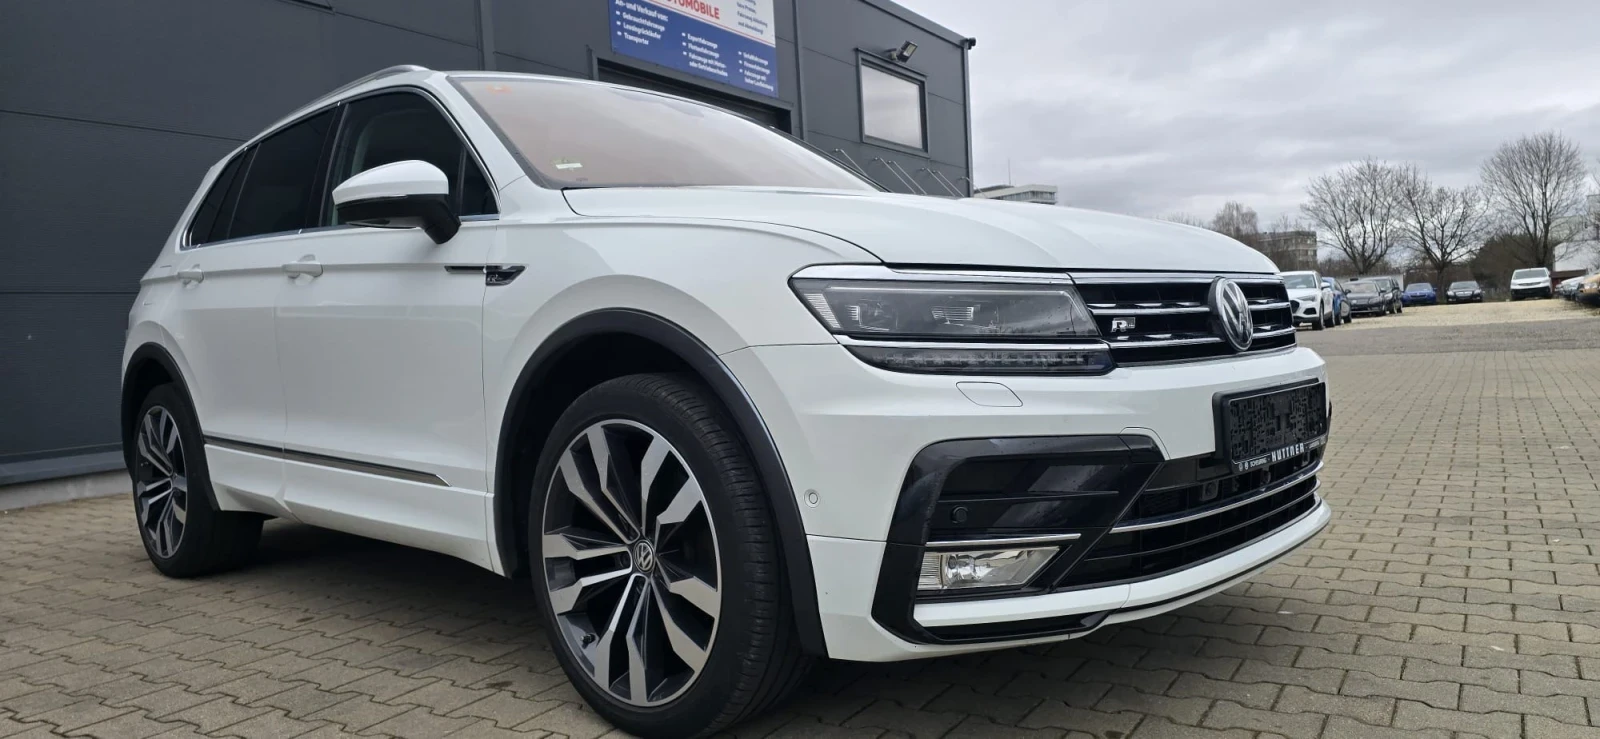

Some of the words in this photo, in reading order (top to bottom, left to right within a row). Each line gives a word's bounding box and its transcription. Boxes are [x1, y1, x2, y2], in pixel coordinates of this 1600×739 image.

[637, 4, 656, 17] Verkauf
[667, 0, 720, 19] OMOBILE
[624, 32, 649, 45] Transporter
